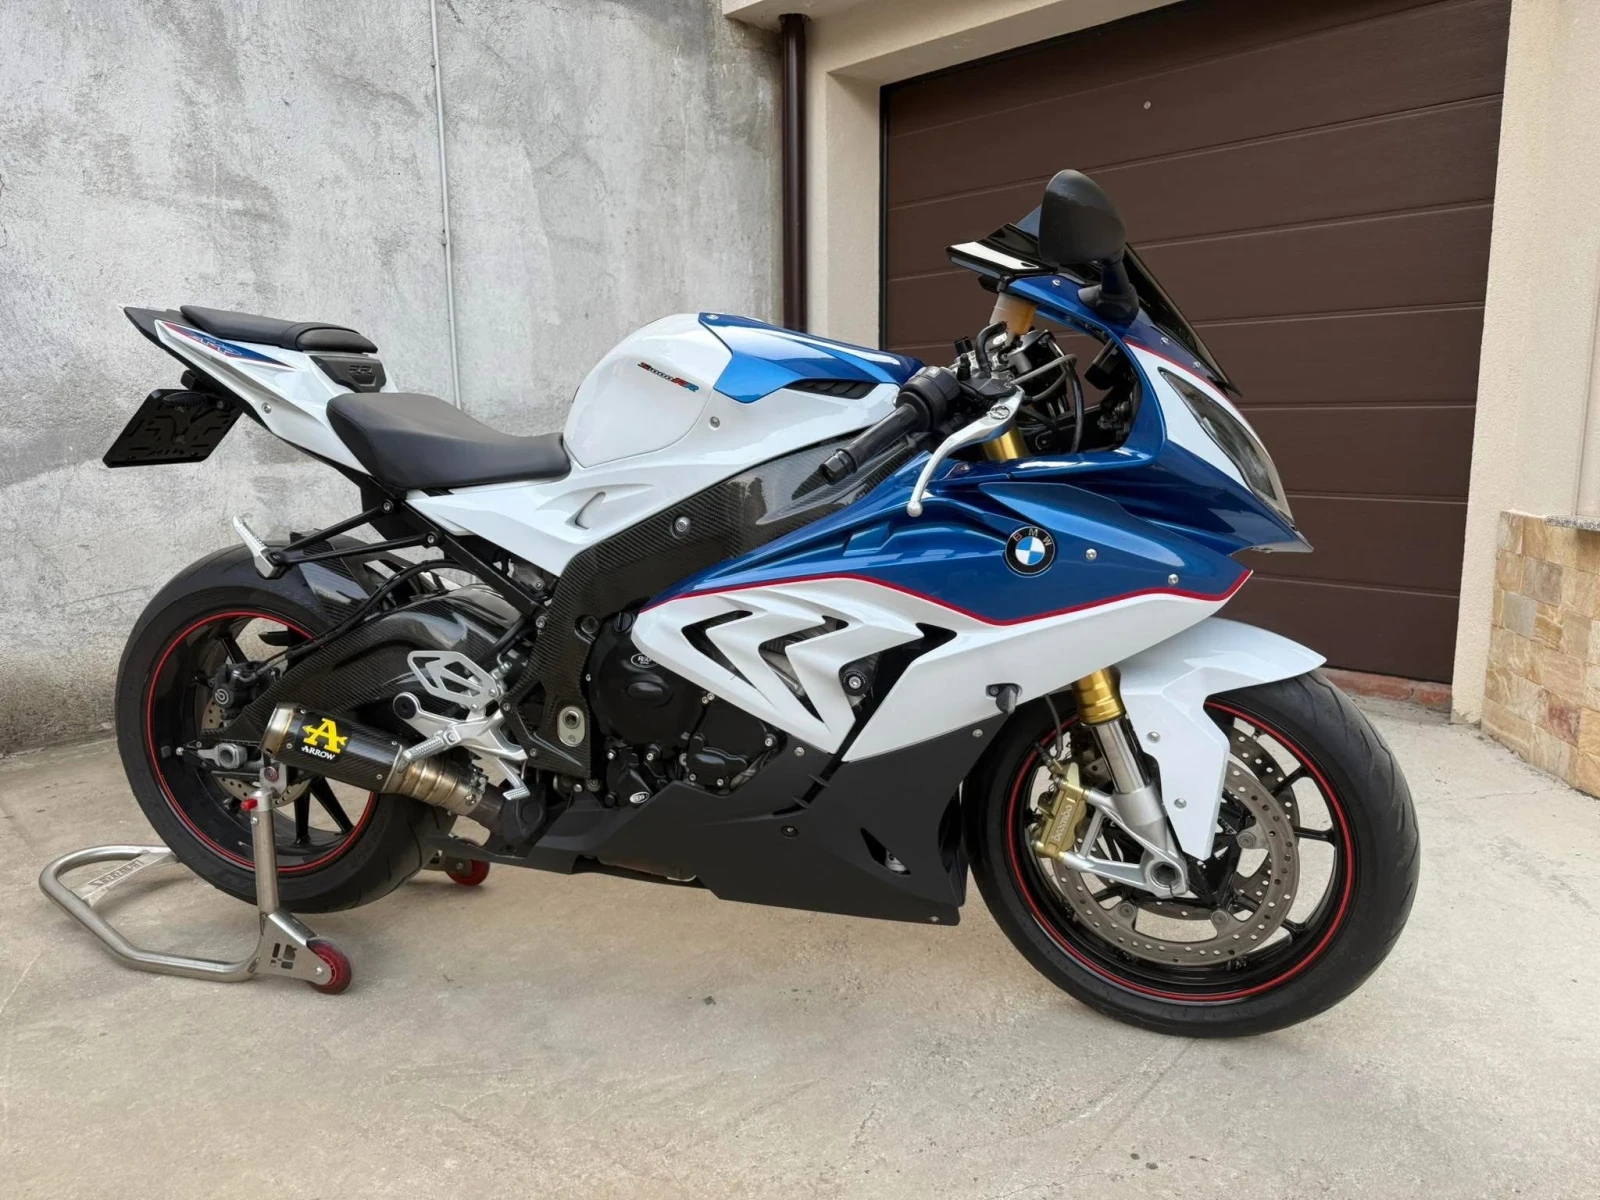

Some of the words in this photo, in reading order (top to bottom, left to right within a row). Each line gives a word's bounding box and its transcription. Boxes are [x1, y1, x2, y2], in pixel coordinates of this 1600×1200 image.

[1012, 528, 1053, 547] BMW
[301, 745, 336, 760] ARROW
[1051, 804, 1073, 842] brembo
